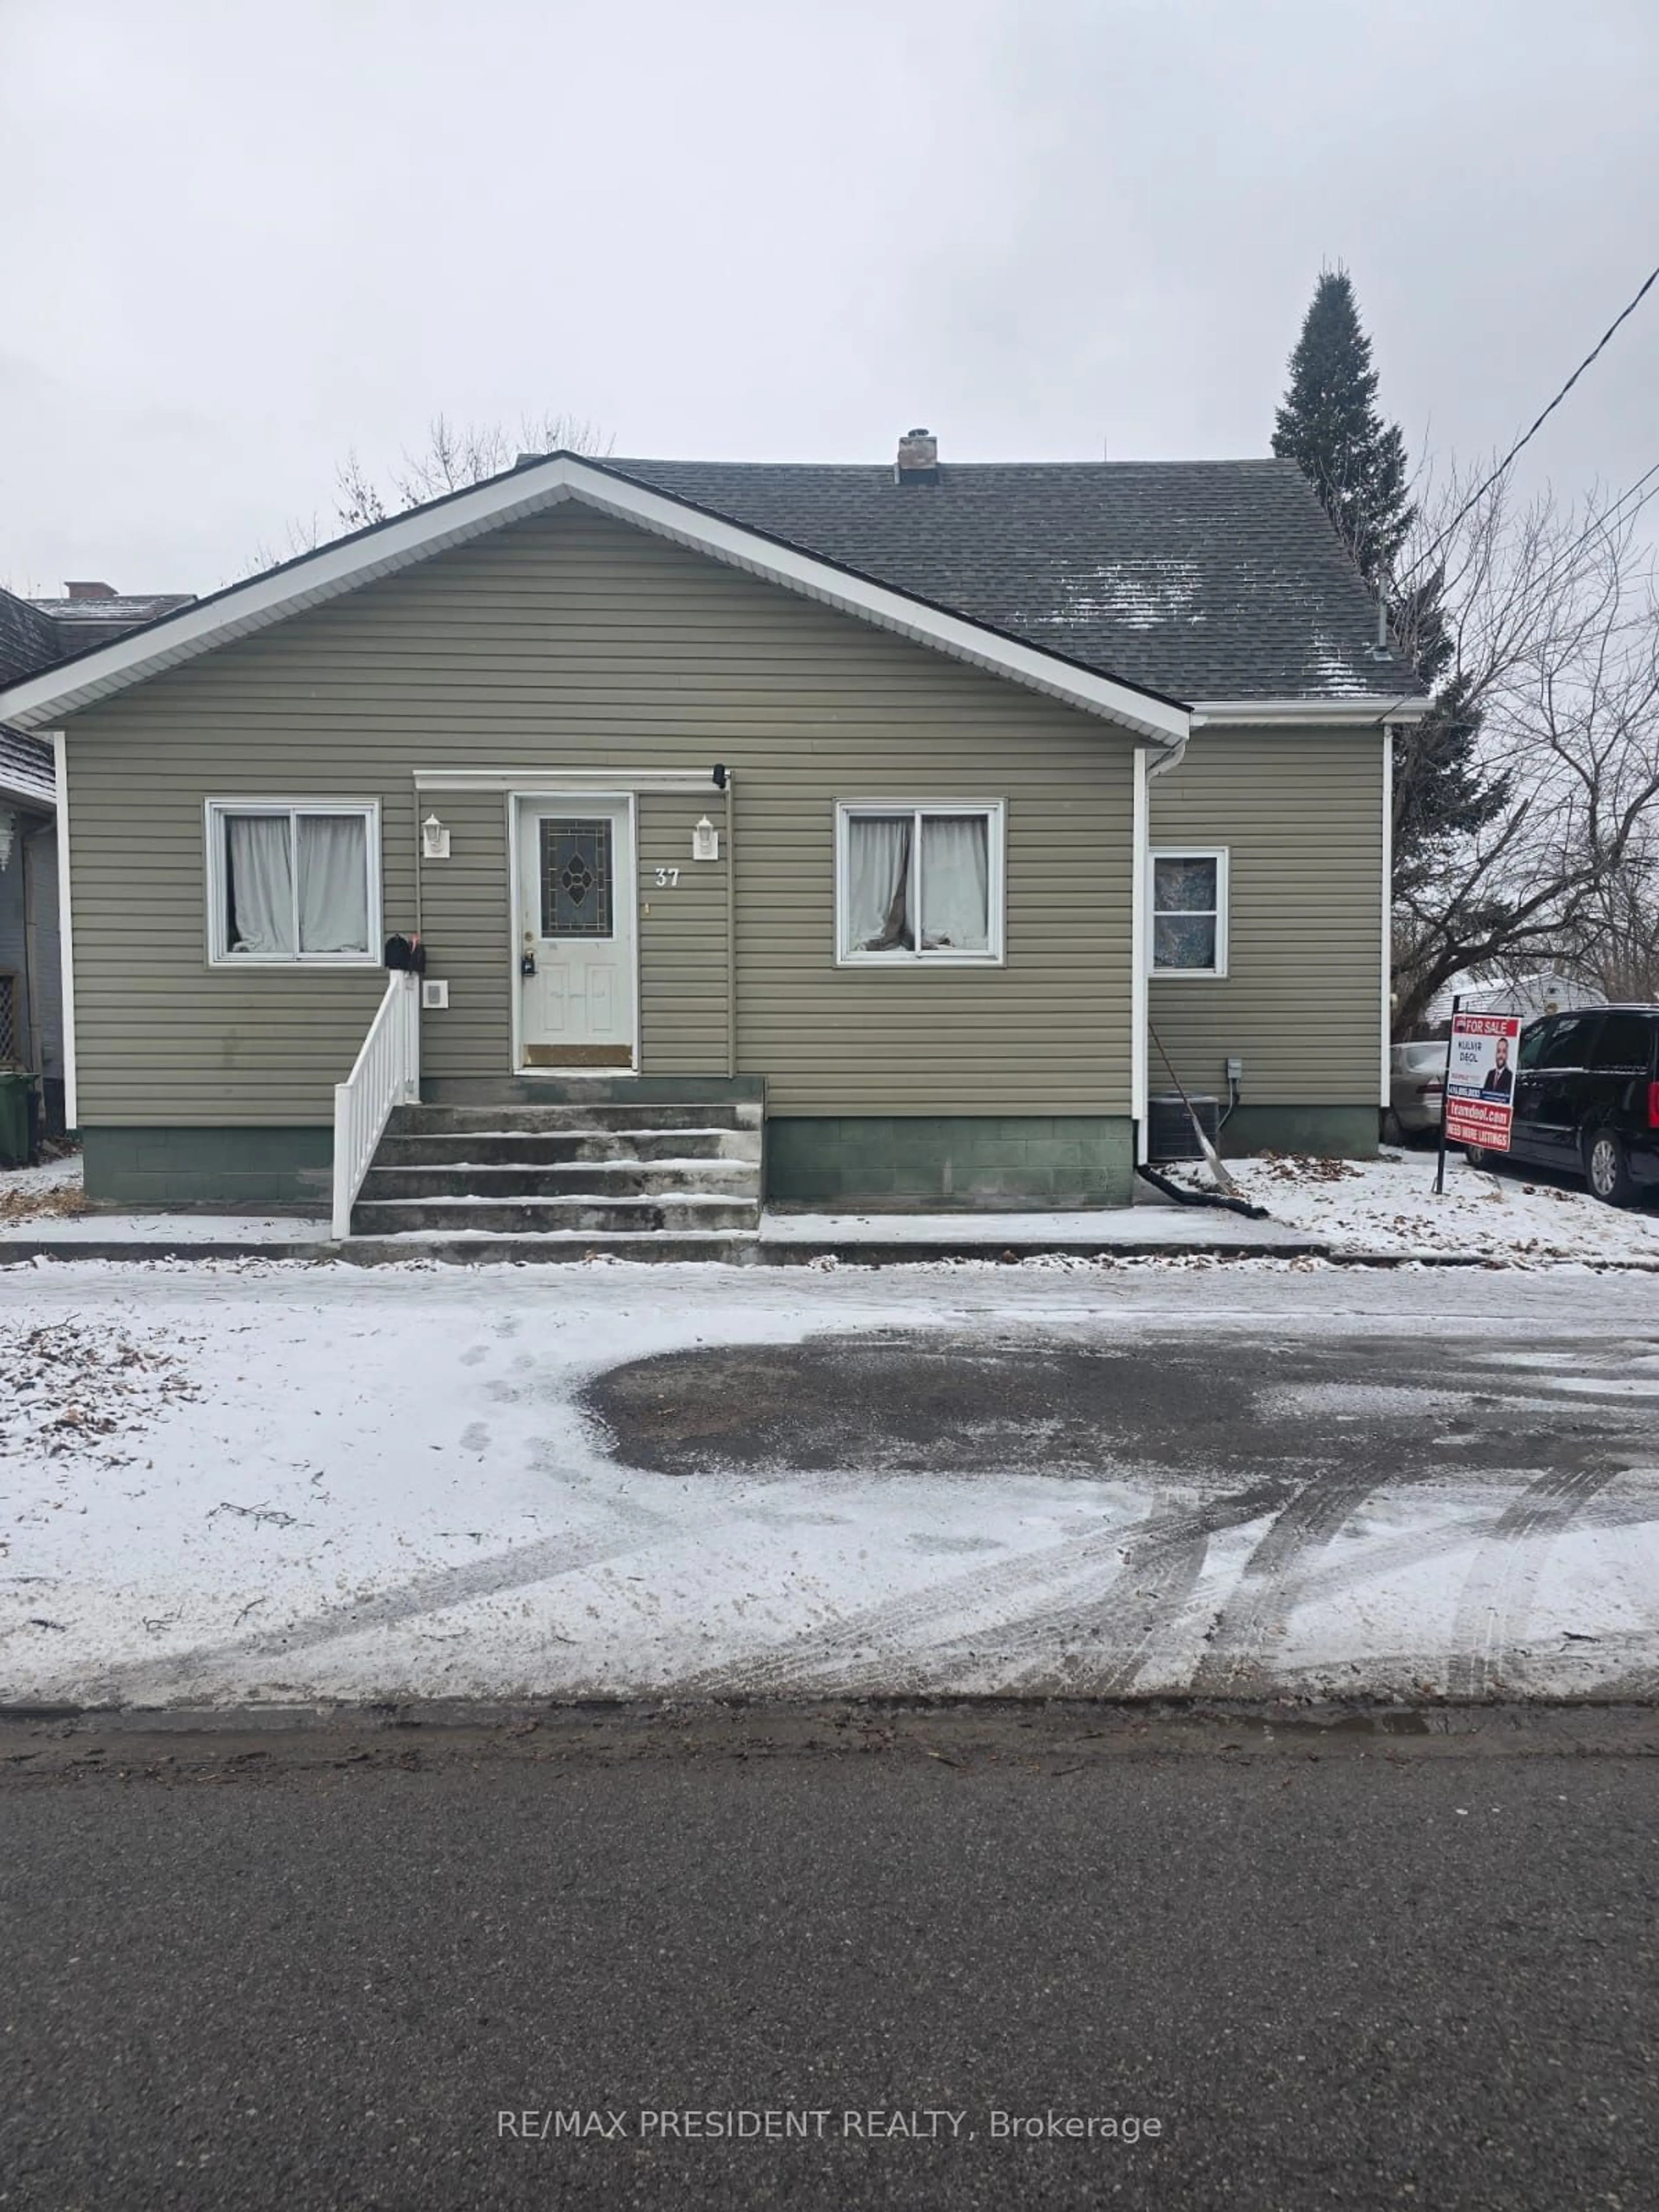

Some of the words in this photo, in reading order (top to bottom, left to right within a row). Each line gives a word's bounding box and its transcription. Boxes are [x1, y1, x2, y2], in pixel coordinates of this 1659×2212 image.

[655, 868, 679, 886] 37
[1466, 1020, 1483, 1033] FOR
[1484, 1021, 1507, 1035] SALE
